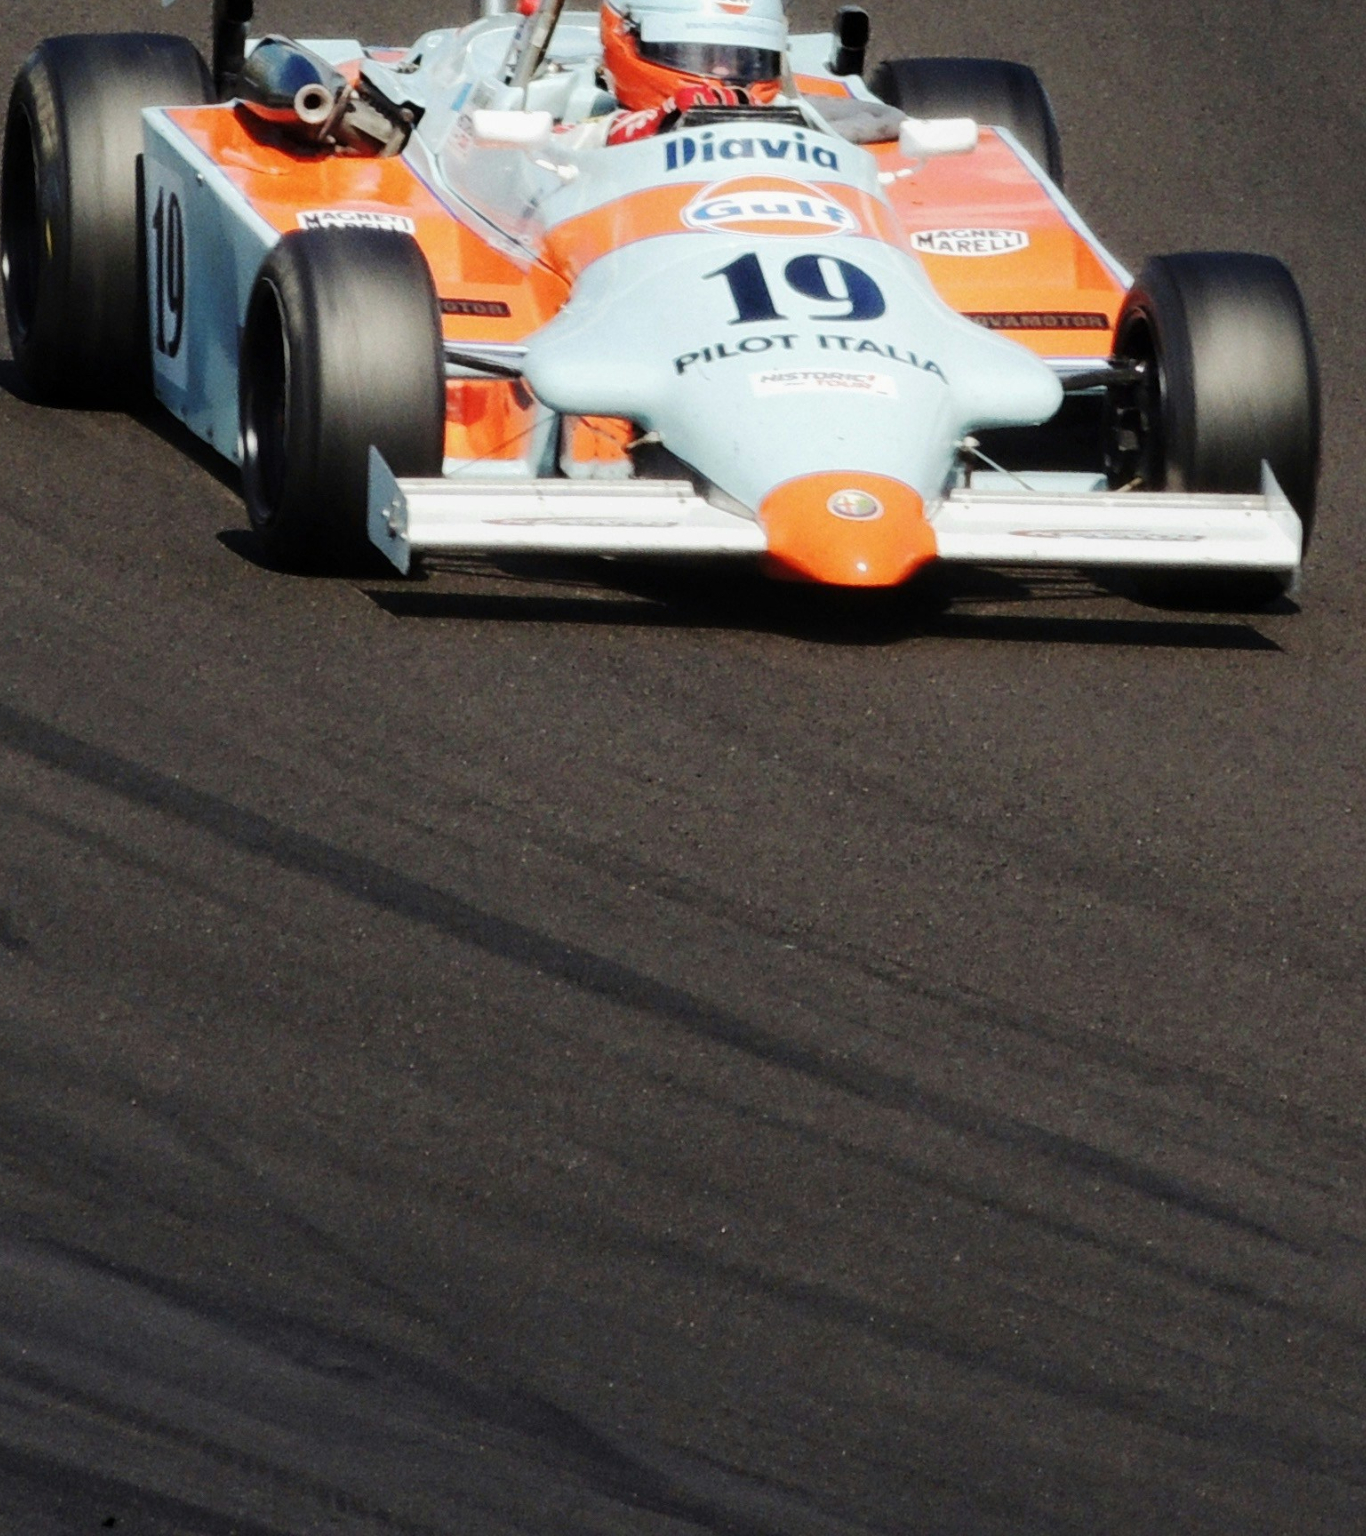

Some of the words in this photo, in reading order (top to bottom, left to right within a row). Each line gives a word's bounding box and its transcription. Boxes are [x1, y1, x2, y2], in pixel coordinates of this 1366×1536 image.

[665, 131, 840, 172] Diavia
[303, 212, 409, 228] MAGNETI
[692, 199, 850, 224] Gulf
[916, 230, 1023, 245] MAGNETI
[916, 233, 1023, 253] MARELLI
[152, 185, 185, 358] 19
[702, 252, 886, 325] 19
[674, 334, 798, 375] PILOT
[816, 334, 949, 384] ITALIA
